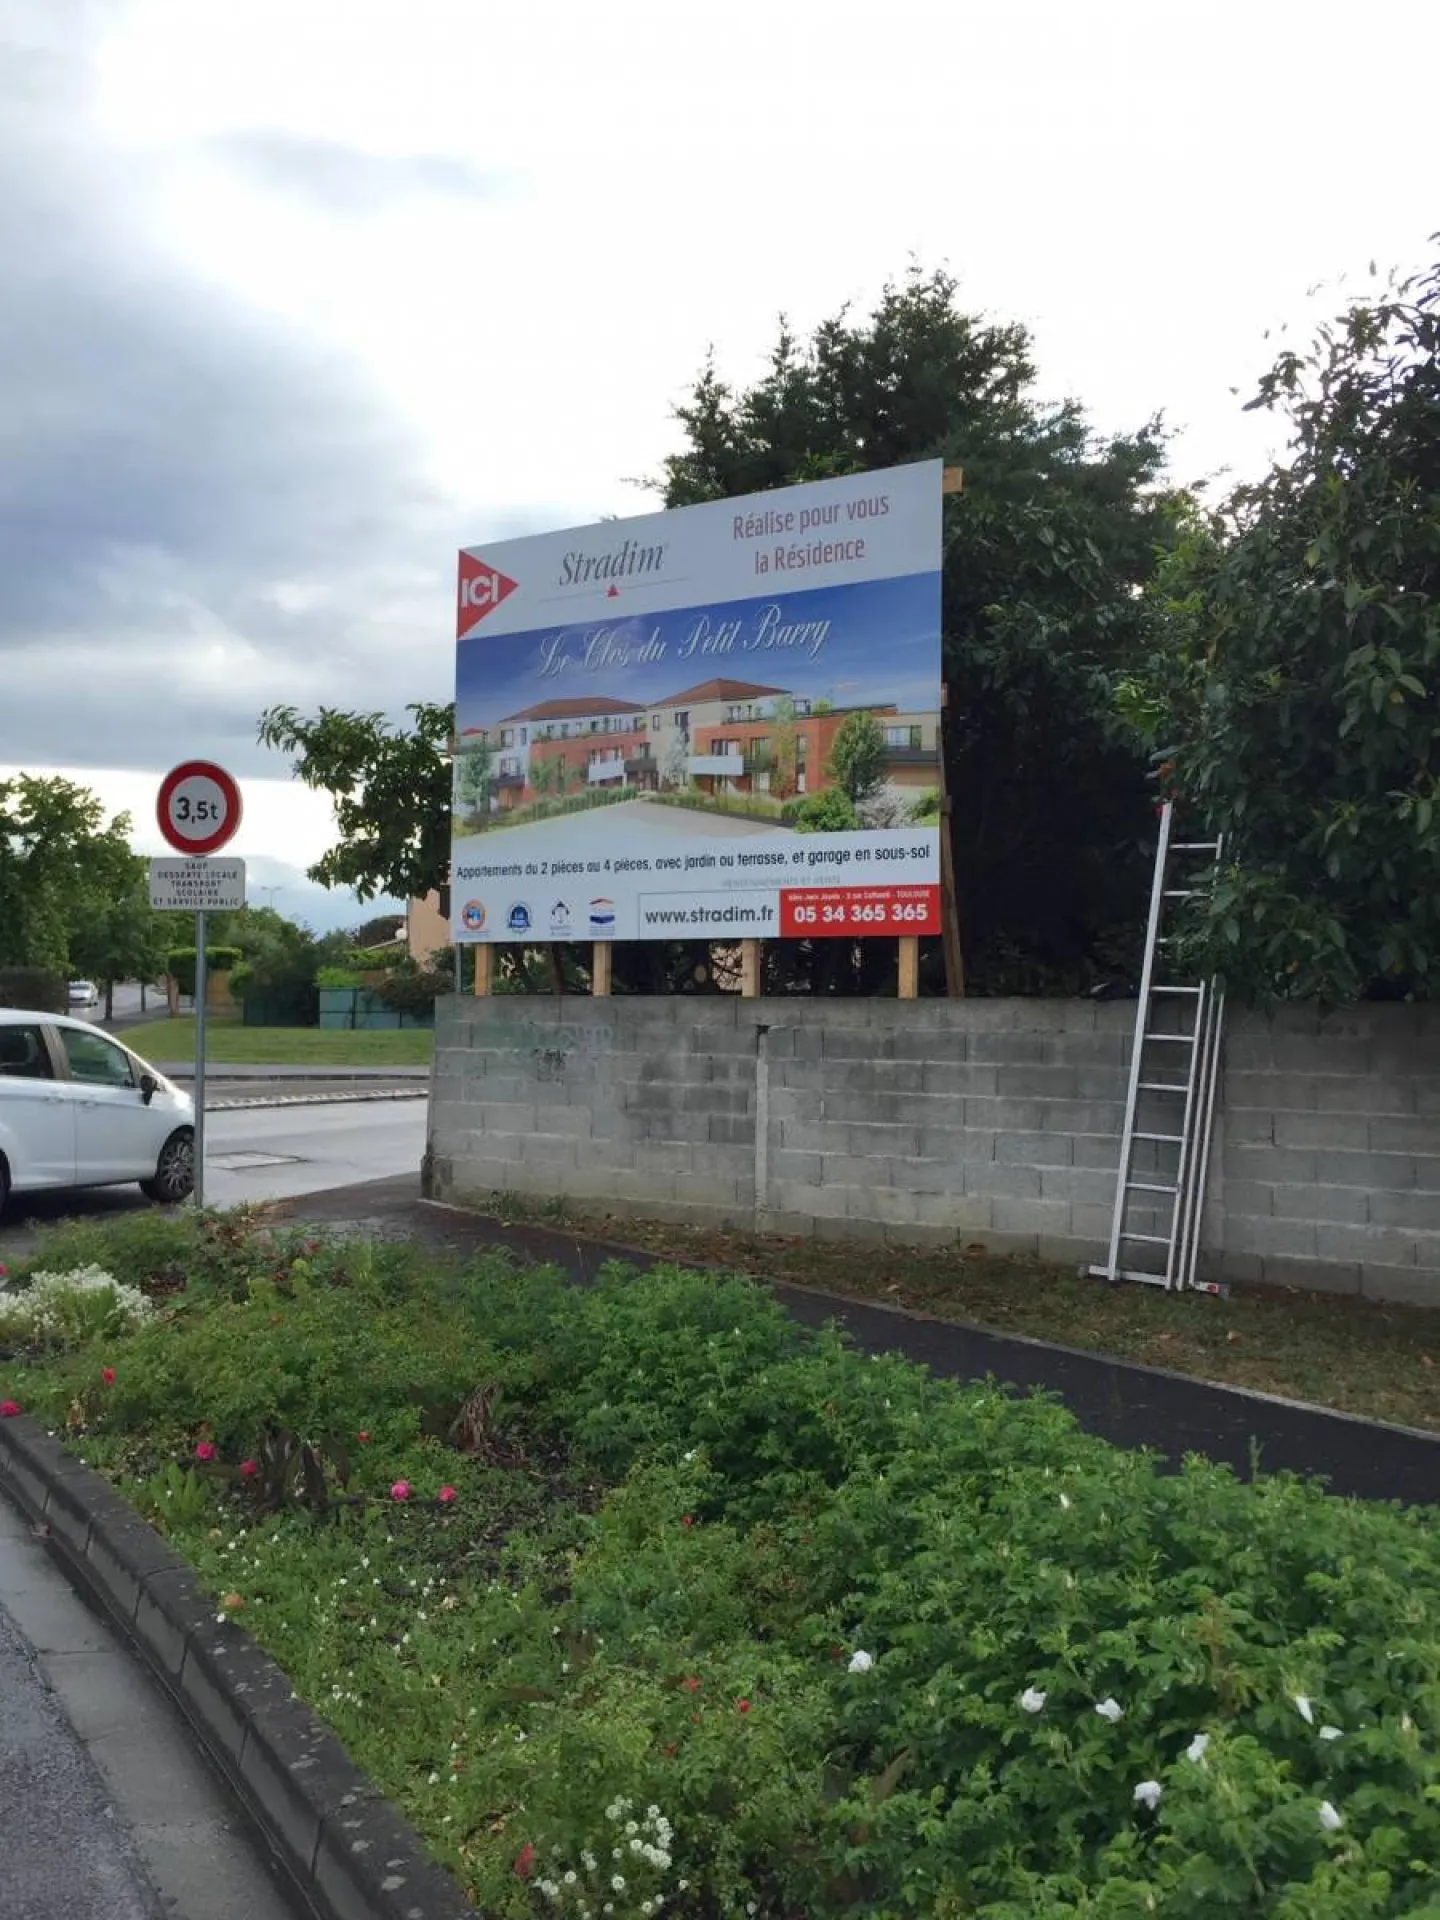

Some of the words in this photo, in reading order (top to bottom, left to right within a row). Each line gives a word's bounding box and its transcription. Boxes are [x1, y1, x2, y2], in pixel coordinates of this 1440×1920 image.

[733, 510, 795, 540] Réalise
[799, 503, 841, 535] pour
[846, 496, 889, 520] vous
[559, 540, 664, 586] Stradim
[754, 551, 769, 574] la
[775, 537, 865, 571] Résidence
[461, 573, 499, 608] ICI
[639, 626, 667, 662] du
[176, 796, 219, 824] 3,5t
[541, 862, 548, 875] 2
[604, 858, 611, 871] 4
[656, 857, 682, 870] avec
[719, 855, 734, 867] ou
[792, 850, 805, 864] et
[808, 850, 851, 866] garage
[855, 849, 871, 860] en
[875, 844, 931, 860] sous-sol
[645, 904, 774, 924] www.stradim.fr
[794, 906, 817, 922] 05
[822, 905, 846, 922] 34
[850, 904, 886, 921] 365
[892, 903, 929, 921] 365
